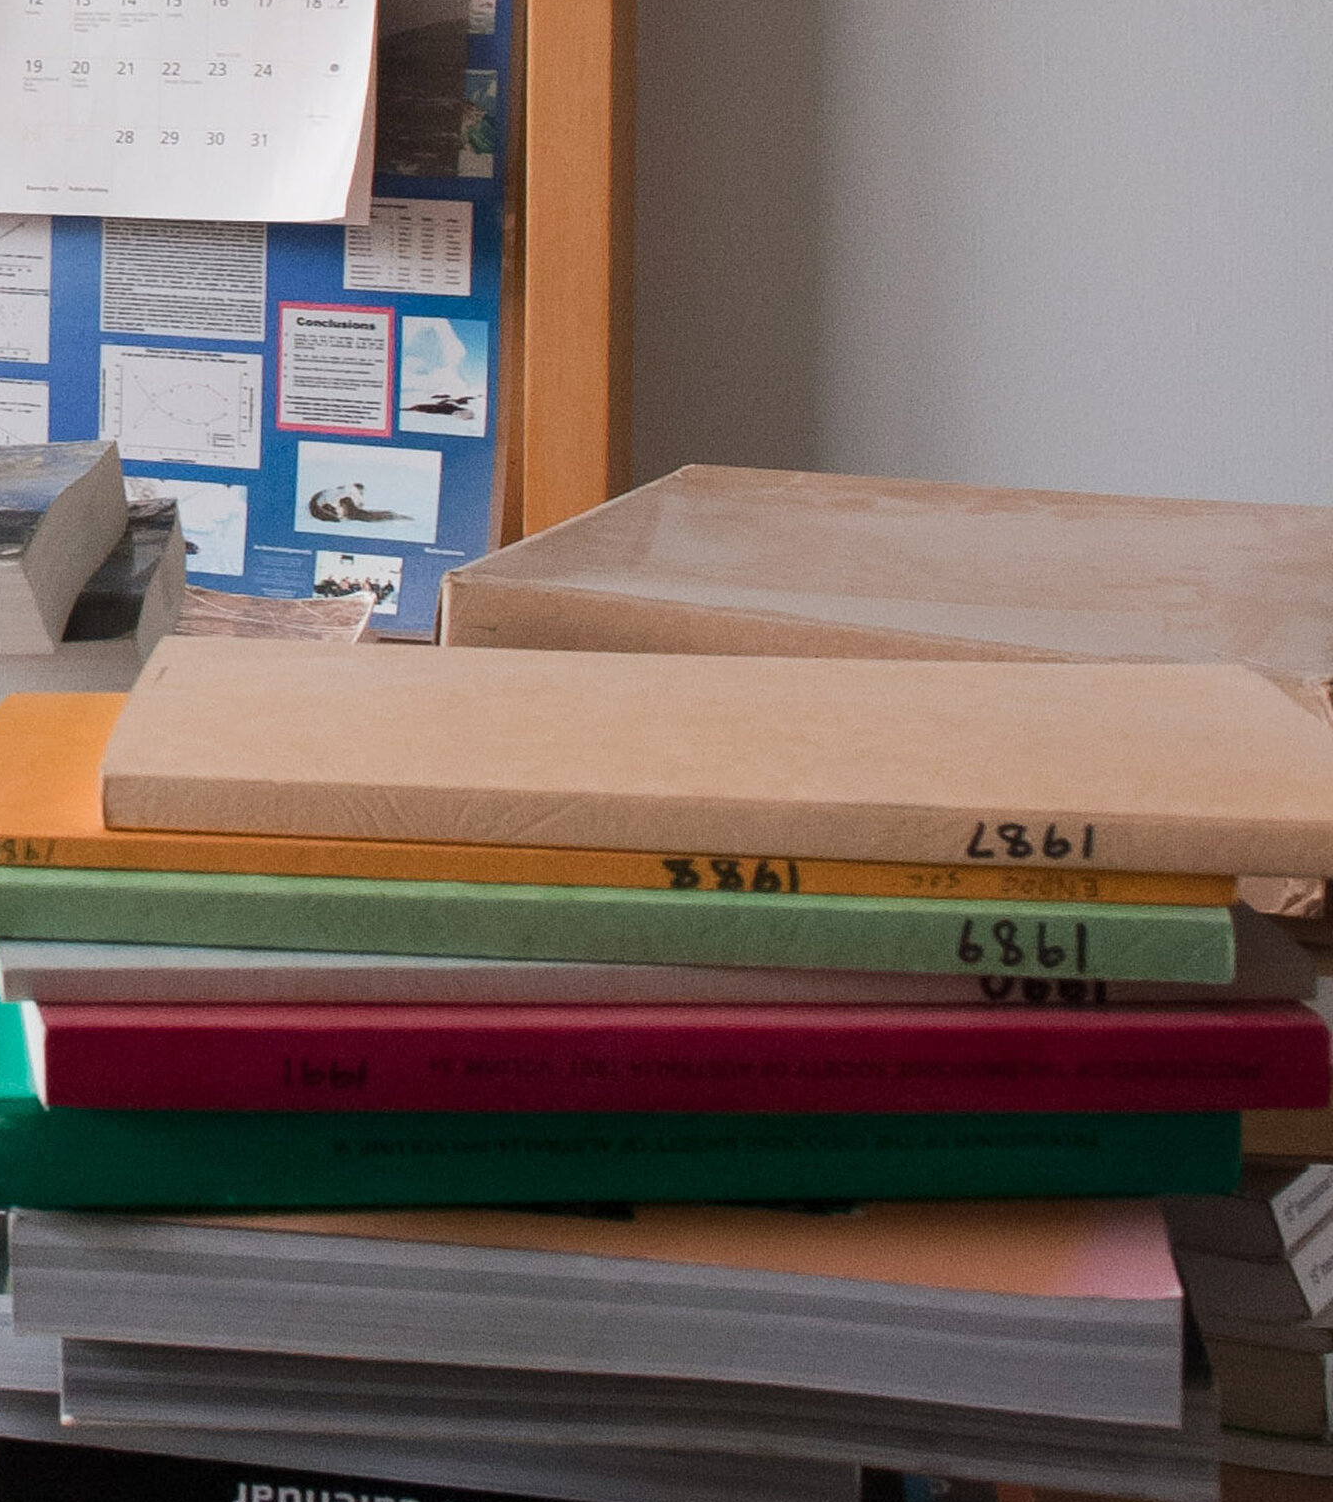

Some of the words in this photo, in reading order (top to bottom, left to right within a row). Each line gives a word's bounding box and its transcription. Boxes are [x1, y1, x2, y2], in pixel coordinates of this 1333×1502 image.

[295, 315, 376, 333] Conclusions
[965, 821, 1096, 861] 1987
[660, 856, 801, 895] 1988
[957, 915, 1088, 975] 1989
